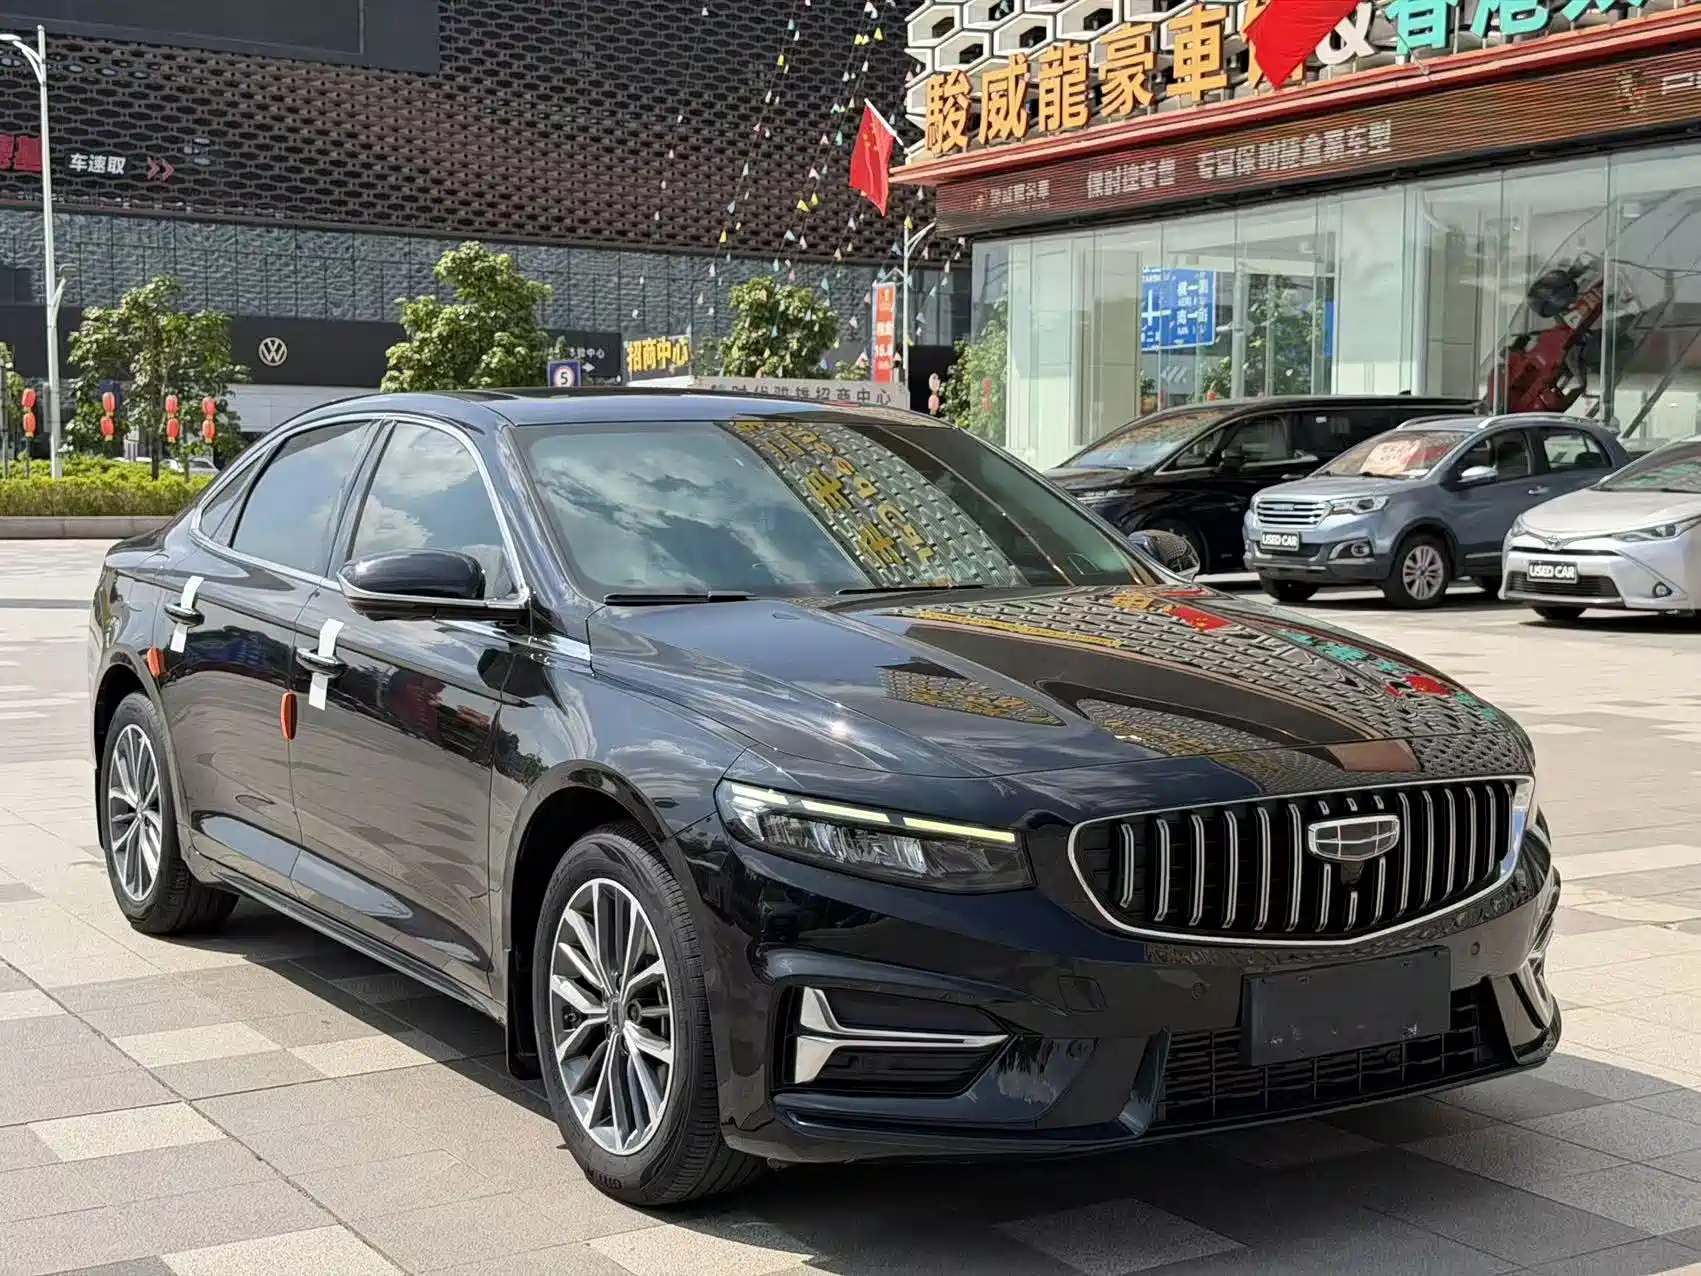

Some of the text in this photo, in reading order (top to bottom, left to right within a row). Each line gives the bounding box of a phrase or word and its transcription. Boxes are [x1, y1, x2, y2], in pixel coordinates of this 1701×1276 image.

[69, 153, 127, 175] 车速取
[627, 336, 689, 372] 招商中心
[1262, 534, 1297, 546] USED CAR
[1529, 564, 1575, 578] USED CAR
